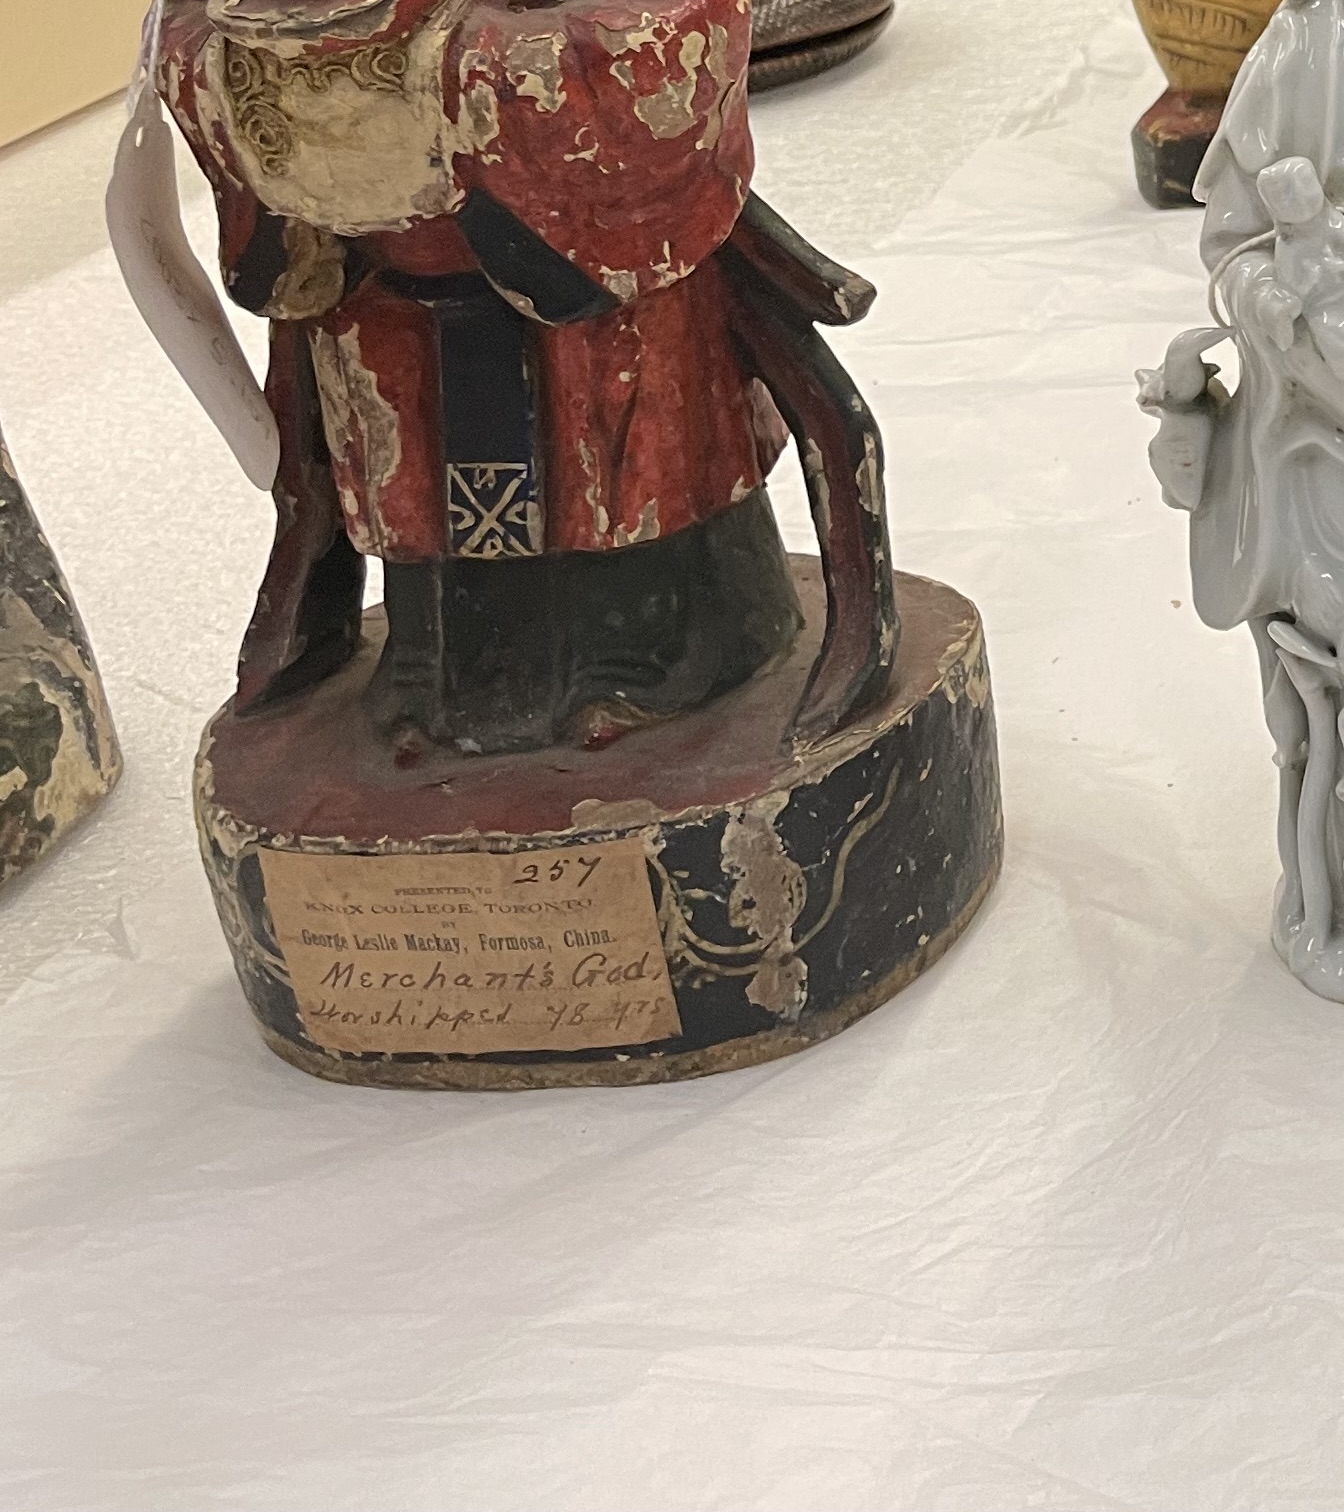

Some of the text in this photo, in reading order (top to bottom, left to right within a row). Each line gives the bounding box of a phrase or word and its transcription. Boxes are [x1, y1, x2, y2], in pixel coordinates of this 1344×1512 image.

[512, 857, 602, 888] 257
[304, 902, 364, 916] KNOX
[302, 929, 618, 955] George Leslie Mackay, Formosa, China.
[320, 960, 554, 990] Merchant's
